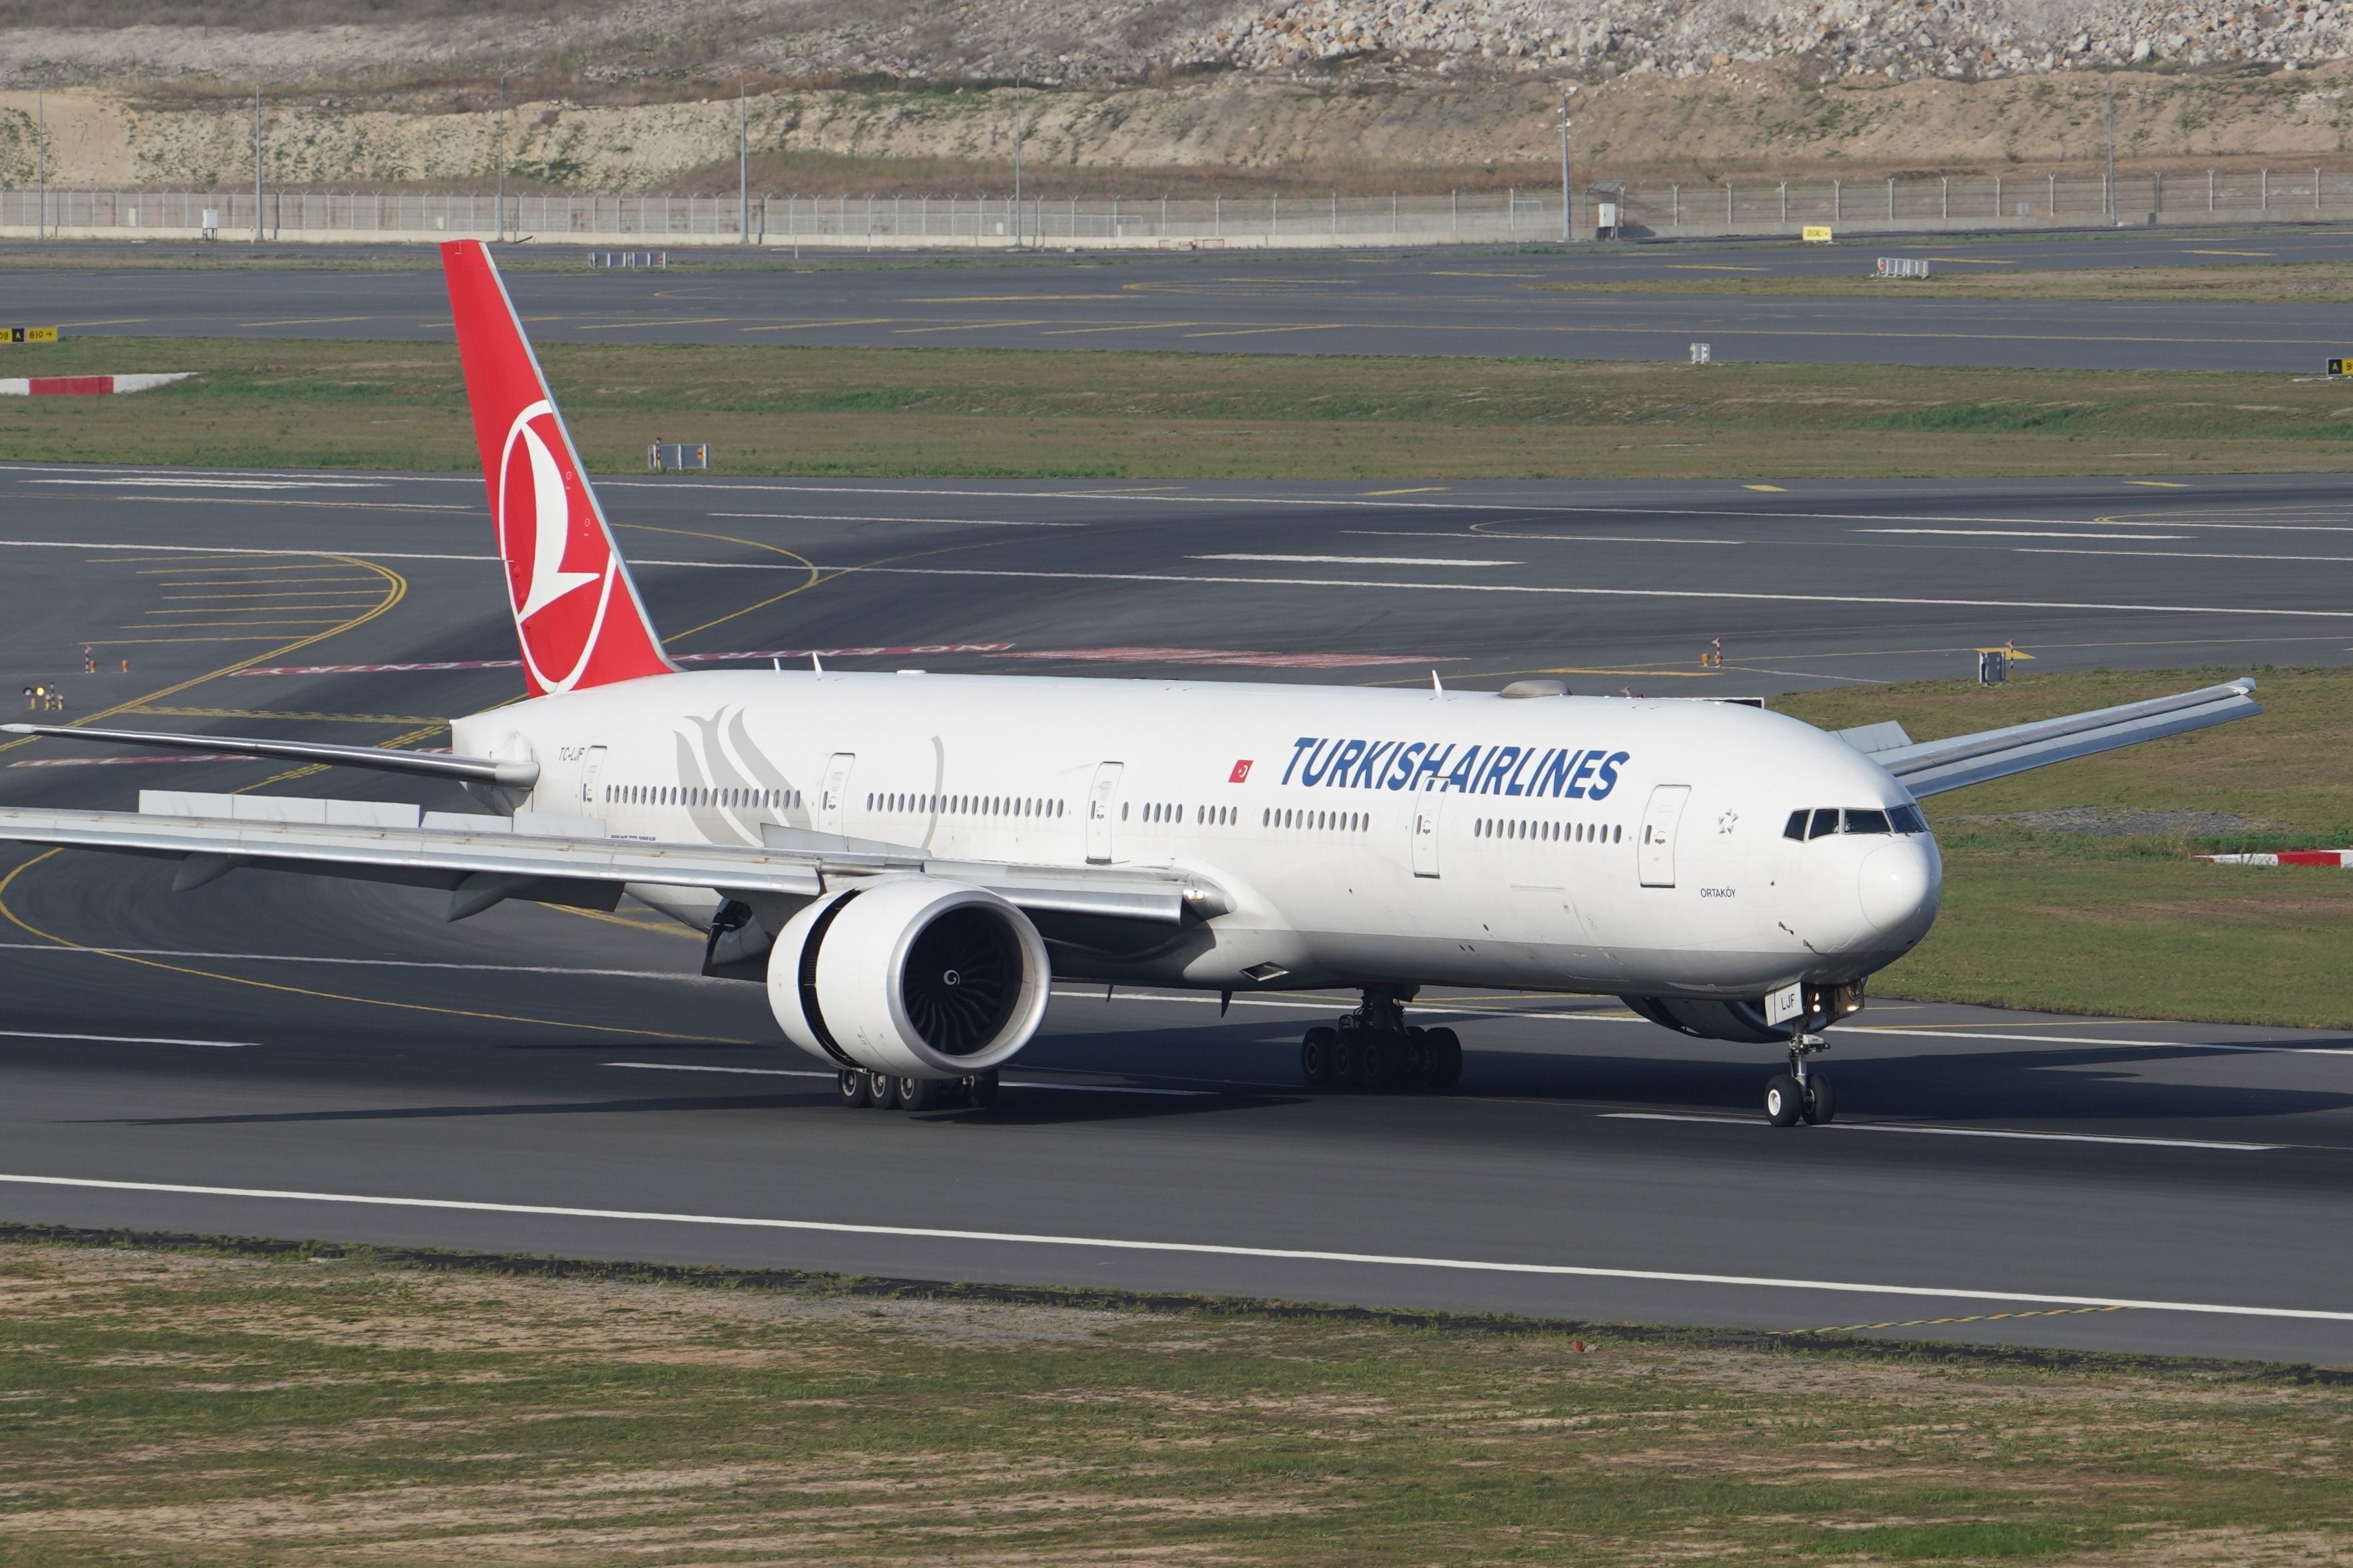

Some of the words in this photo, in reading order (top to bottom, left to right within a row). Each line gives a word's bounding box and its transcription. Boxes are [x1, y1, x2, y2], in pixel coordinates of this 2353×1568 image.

[2332, 362, 2339, 371] A
[1281, 737, 1457, 792] TURKISH
[1439, 745, 1630, 801] AIRLINES
[1700, 885, 1735, 898] ORTAKÖY
[1781, 993, 1795, 1011] LJF
